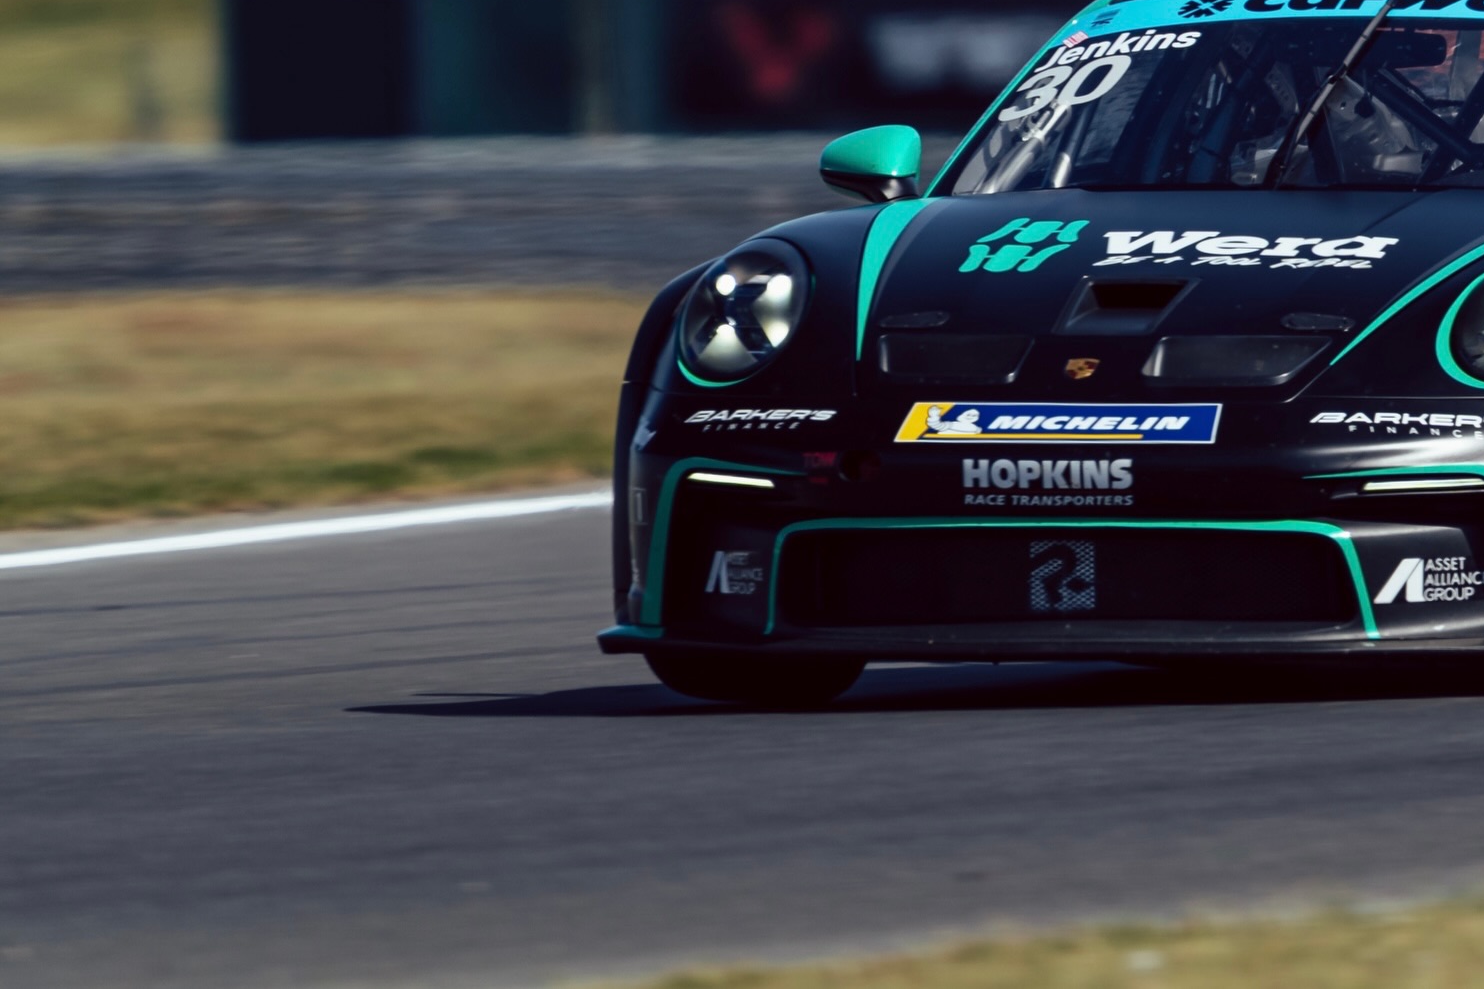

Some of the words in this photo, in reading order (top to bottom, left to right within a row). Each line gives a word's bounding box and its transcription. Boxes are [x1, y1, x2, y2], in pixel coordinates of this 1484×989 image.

[1034, 30, 1202, 73] Jenkins
[998, 55, 1132, 121] 30
[1103, 231, 1399, 258] Wera
[684, 409, 837, 423] BARKER'S
[987, 416, 1191, 431] MICHELIN
[1348, 425, 1483, 439] FINANCE
[963, 459, 1133, 489] HOPKINS
[964, 494, 1005, 505] RACE
[1011, 494, 1133, 506] TRANSPORTERS
[1425, 557, 1467, 571] ASSET
[1423, 587, 1475, 601] GROUP
